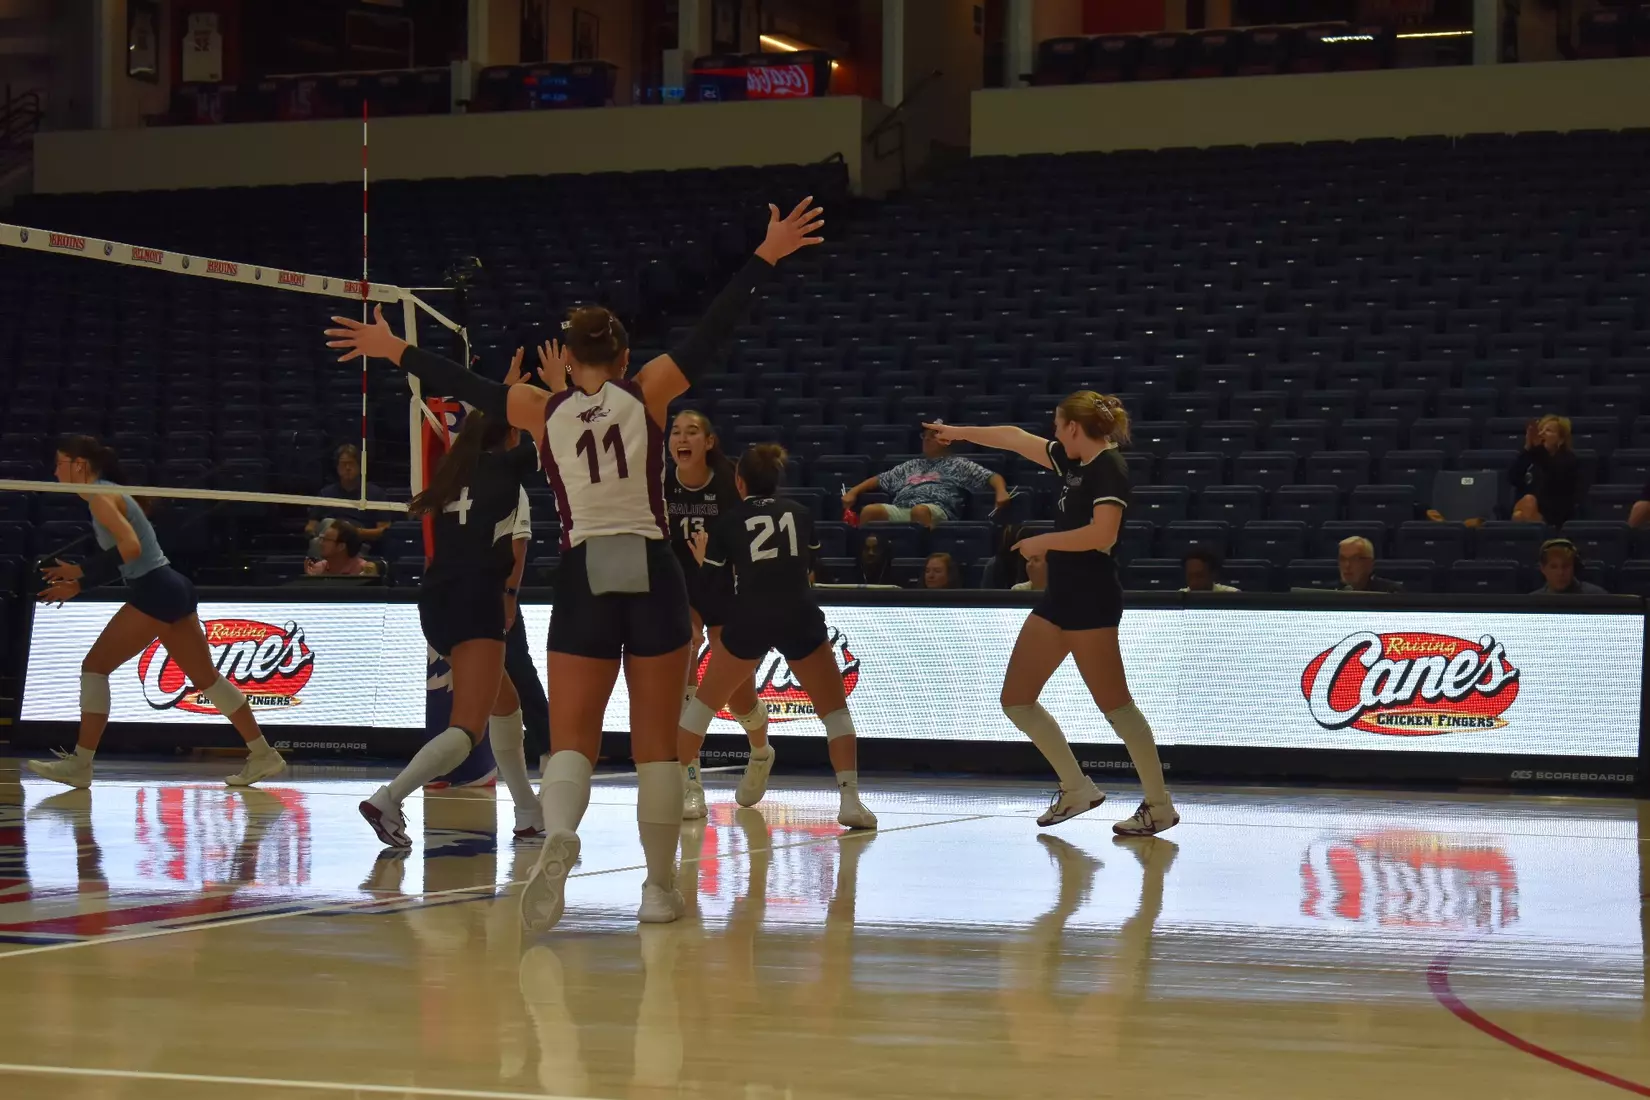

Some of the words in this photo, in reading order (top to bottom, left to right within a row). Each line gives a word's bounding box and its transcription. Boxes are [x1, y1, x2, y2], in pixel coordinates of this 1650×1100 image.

[49, 233, 86, 252] BRUINS
[132, 247, 164, 265] BELMONT
[206, 260, 238, 277] BRUINS
[277, 269, 306, 287] BELMONT
[576, 423, 629, 484] 11
[668, 502, 719, 516] SALUKIS
[744, 511, 798, 562] 21
[208, 623, 268, 643] Raising
[1384, 636, 1457, 659] Raising
[142, 620, 315, 710] Cne's
[1309, 631, 1520, 730] Cane's
[246, 694, 291, 706] FINGERS
[785, 702, 815, 715] FING
[1377, 713, 1434, 726] CHICKEN
[1437, 714, 1494, 728] FINGERS
[293, 741, 367, 749] SCOREBOARDS
[699, 750, 750, 759] EBOARDS
[1082, 760, 1171, 770] SCOREBOS
[1535, 771, 1635, 782] SCOREBOARDS
